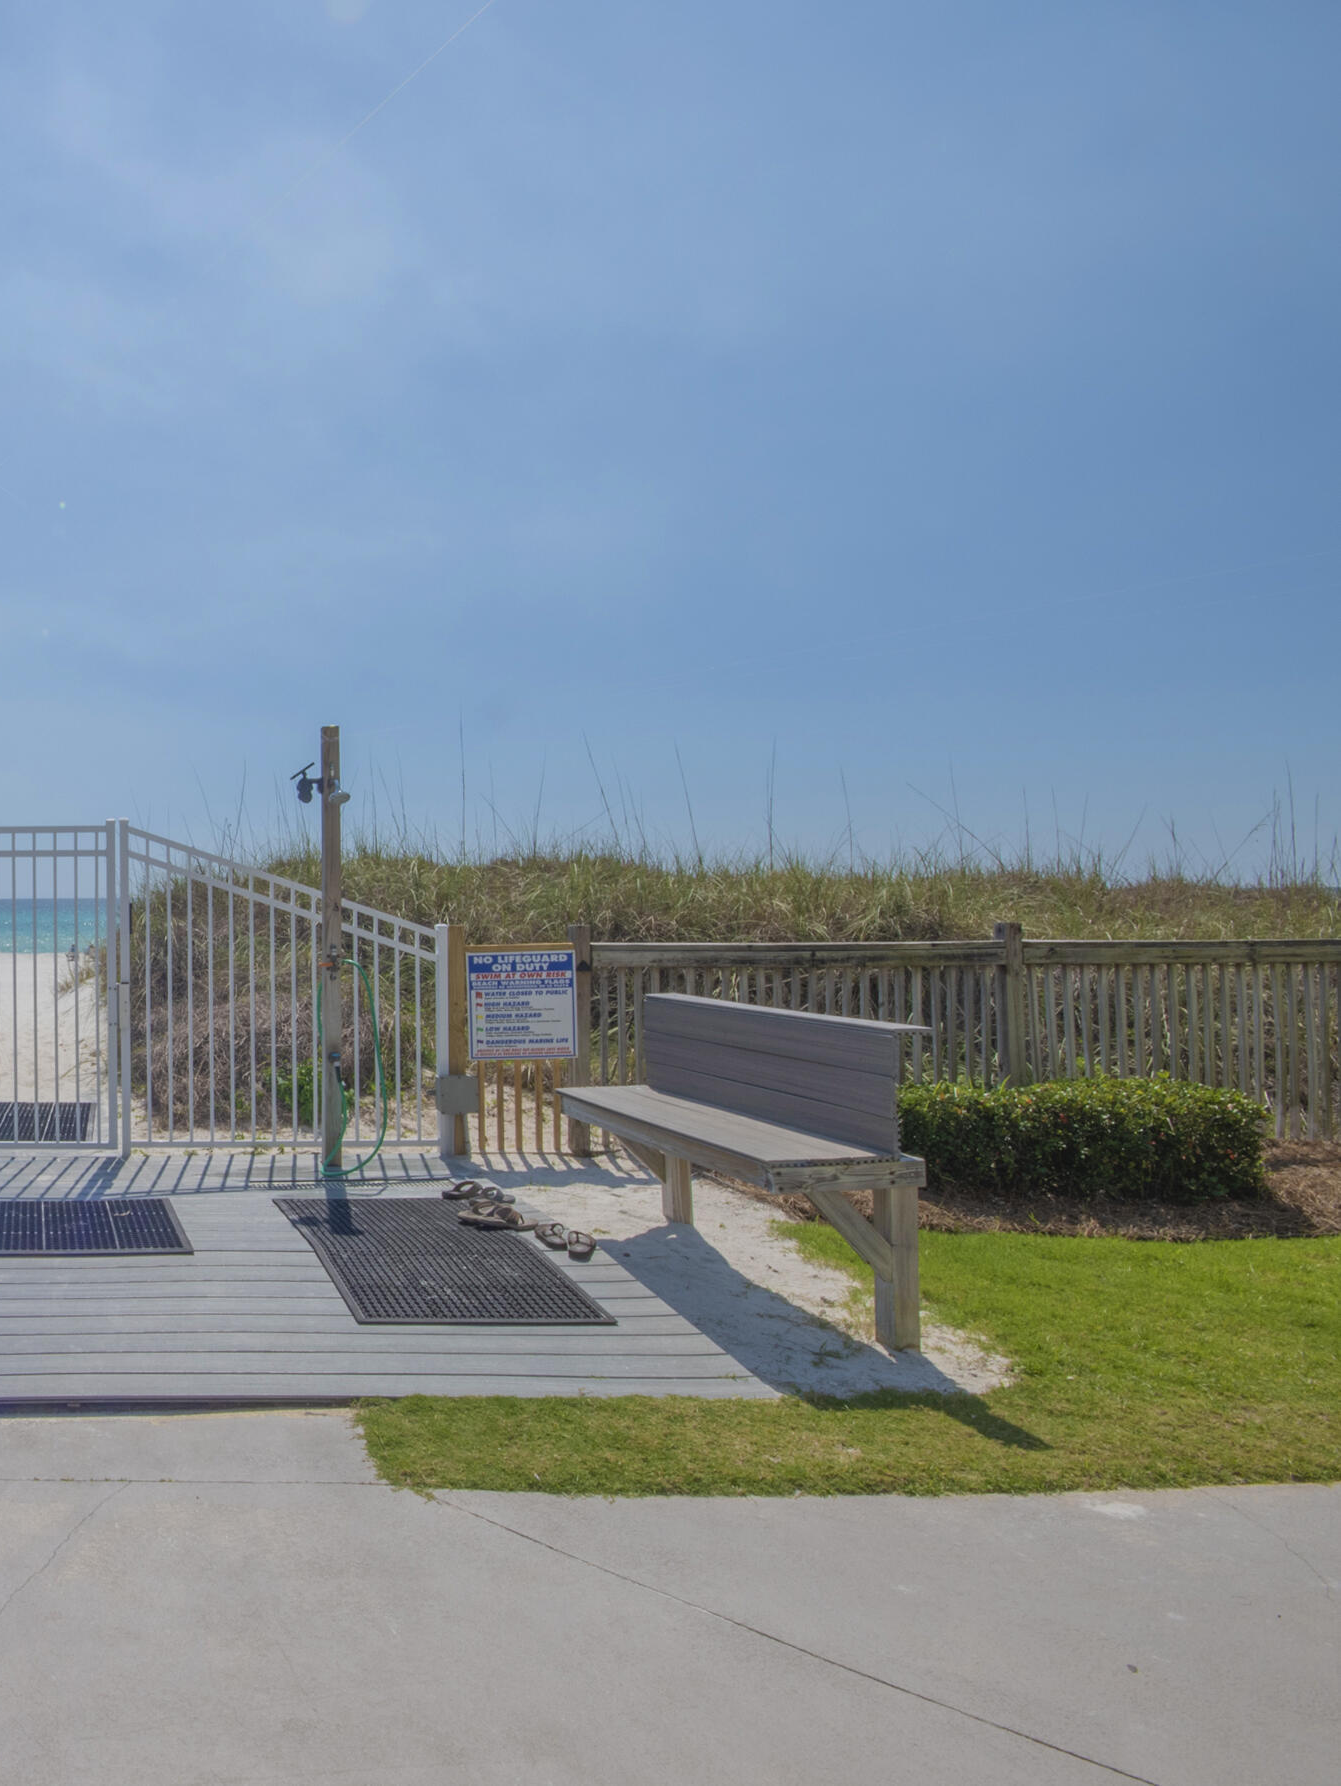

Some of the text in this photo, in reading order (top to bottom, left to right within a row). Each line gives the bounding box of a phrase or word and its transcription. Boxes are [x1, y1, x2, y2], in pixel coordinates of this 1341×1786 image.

[473, 954, 568, 964] NO LIFEGUARD
[492, 963, 549, 972] ON DUTY
